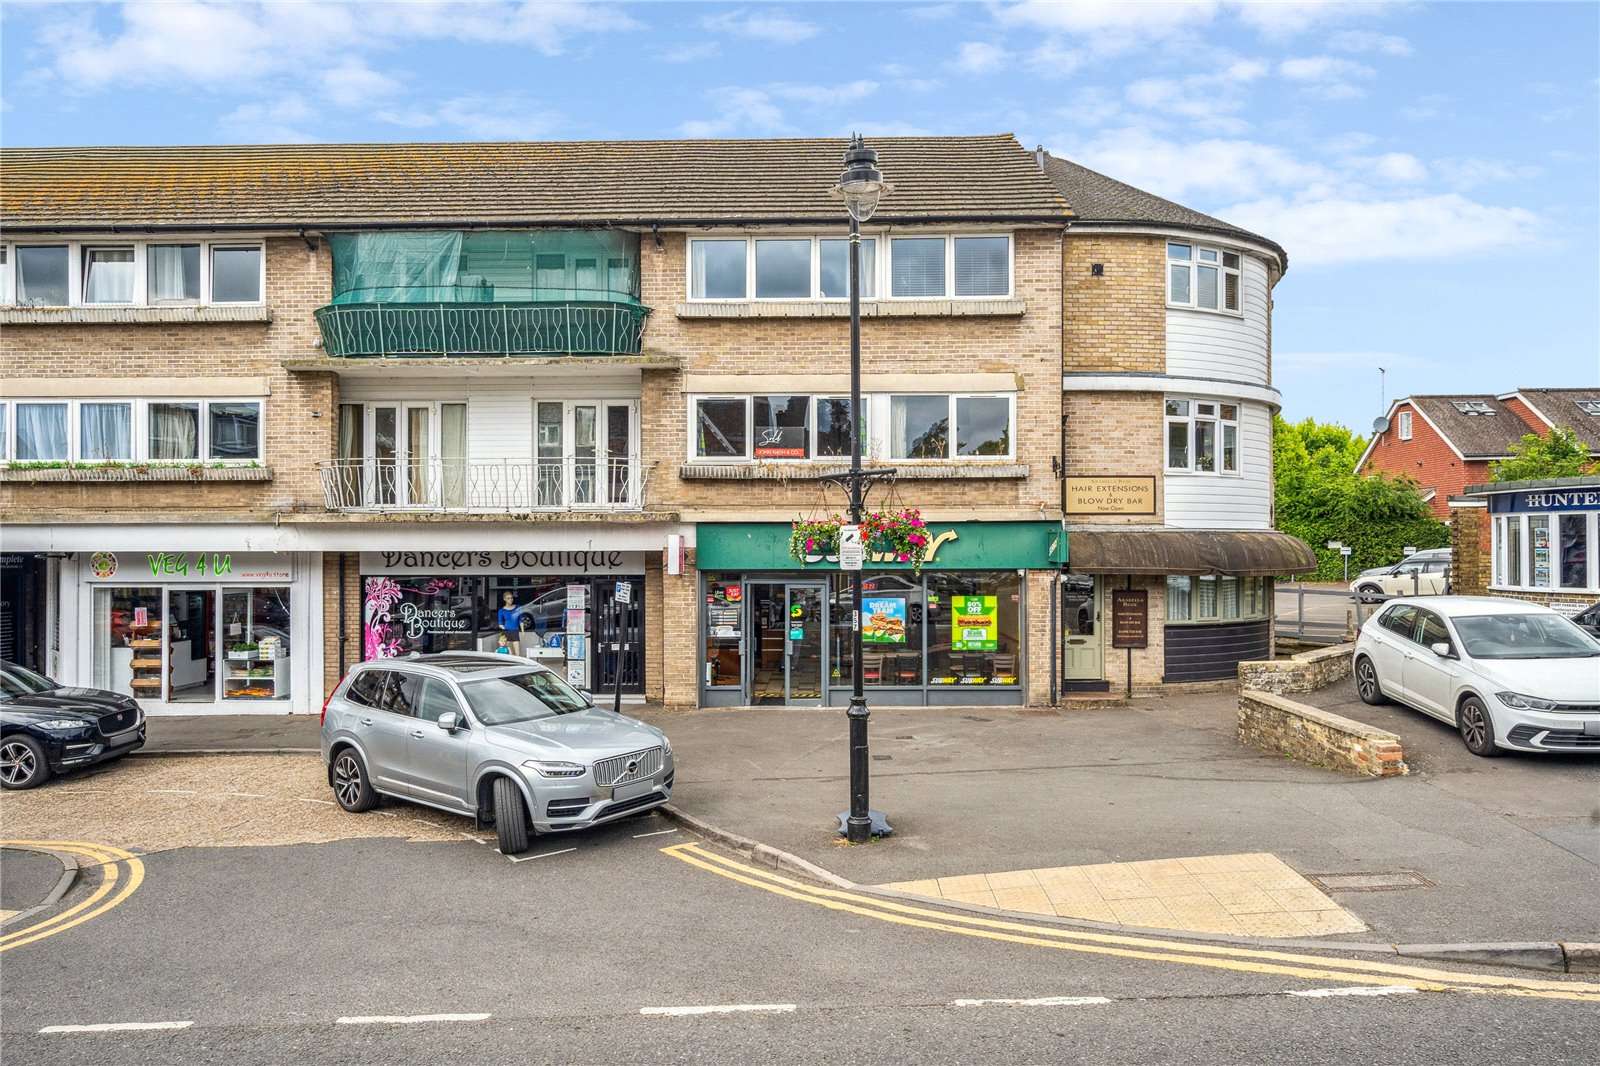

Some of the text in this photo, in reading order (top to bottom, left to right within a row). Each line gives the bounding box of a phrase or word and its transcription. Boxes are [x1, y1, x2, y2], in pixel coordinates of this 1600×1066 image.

[759, 429, 784, 446] Sold
[1077, 497, 1143, 505] BLOW DRY BAR
[1525, 492, 1600, 507] HUNTE
[147, 552, 233, 577] VEG 4 U
[383, 551, 492, 570] Dancers
[400, 602, 456, 624] Dancers
[407, 616, 466, 638] Boutique
